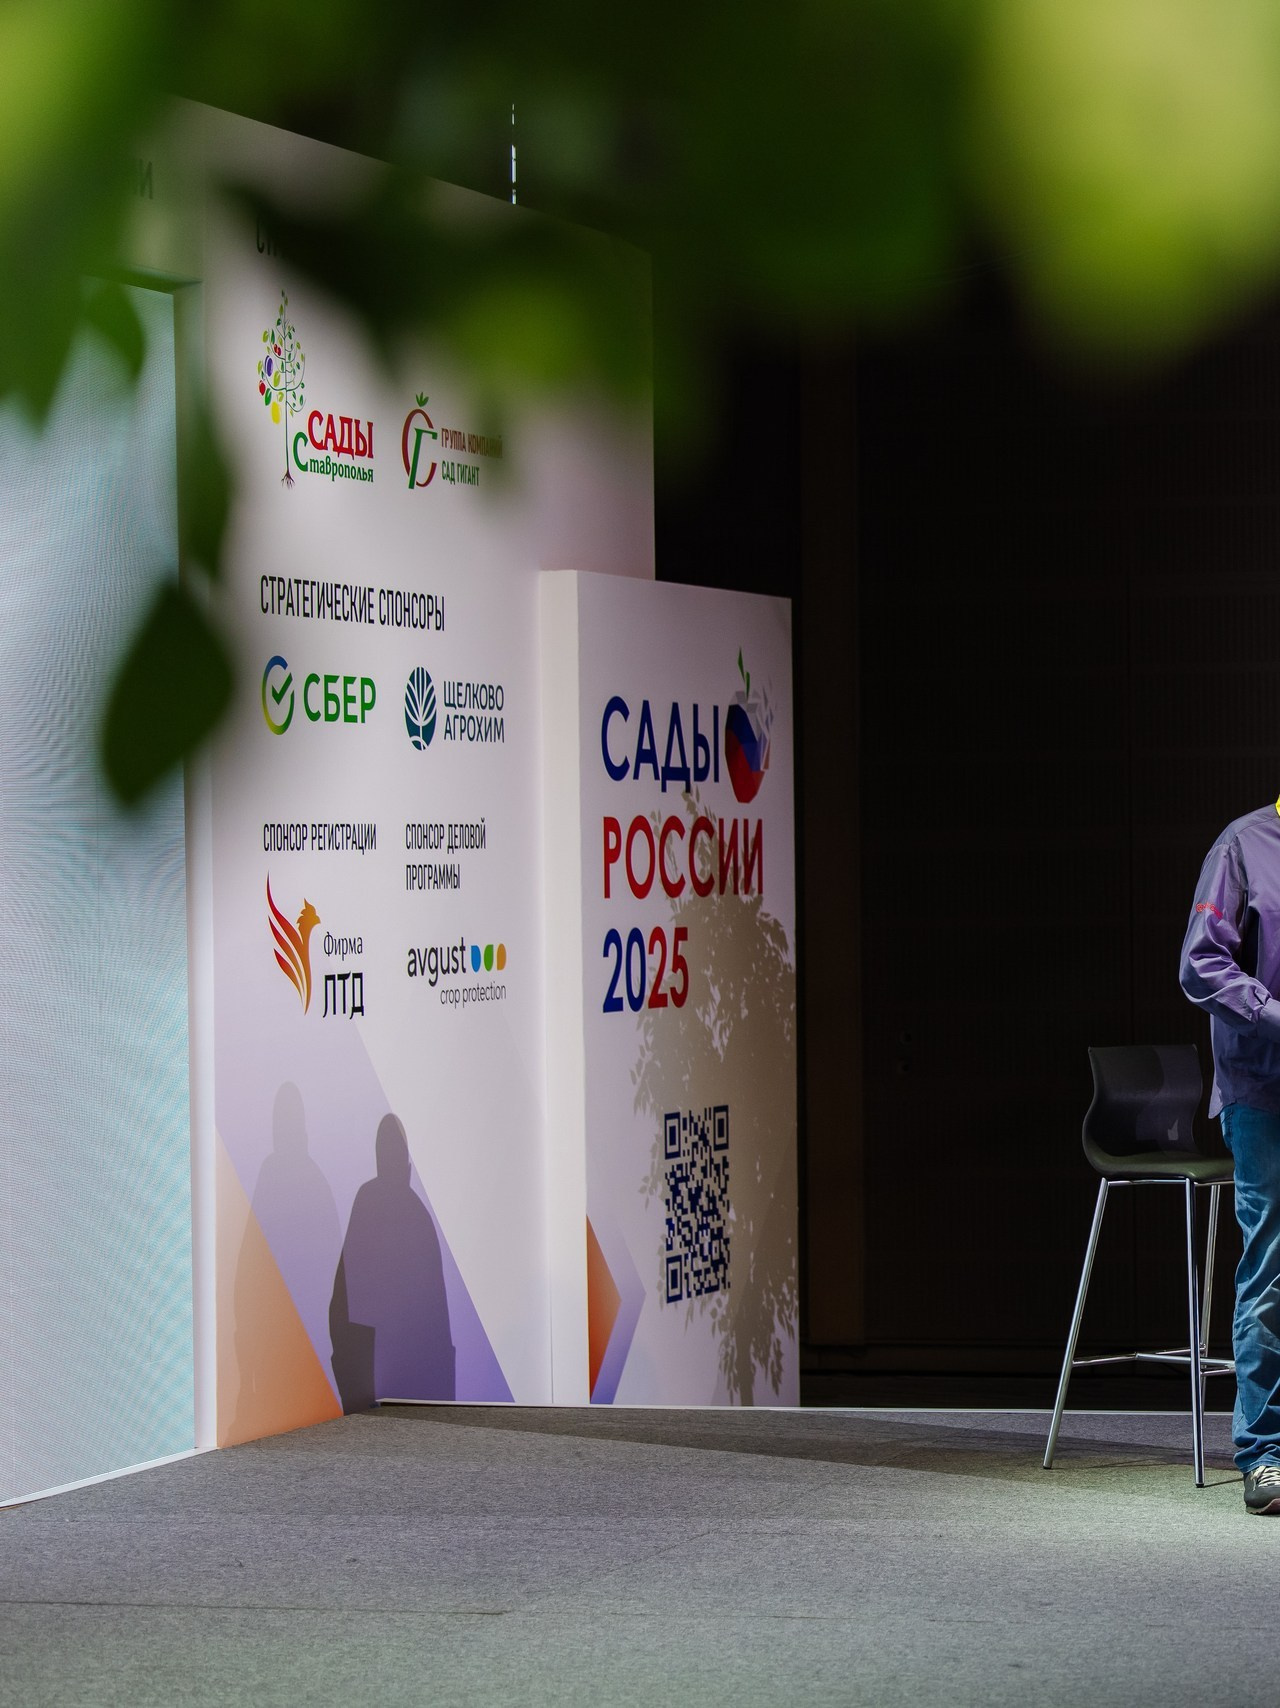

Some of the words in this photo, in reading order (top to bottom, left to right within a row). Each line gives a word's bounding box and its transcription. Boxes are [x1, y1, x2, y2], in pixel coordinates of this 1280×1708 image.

[308, 409, 374, 460] САДЫ
[441, 428, 467, 453] ГРУППА
[293, 431, 374, 483] Ставрополья
[441, 460, 456, 486] САД
[457, 463, 480, 487] ГИГАНТ
[260, 574, 375, 625] СТРАТЕГИЧЕСКИЕ
[378, 588, 445, 632] СПОНСОРЫ
[303, 672, 377, 724] СБЕР
[443, 680, 505, 712] ЩЕЛКОВО
[443, 714, 505, 743] АГРОХИМ
[601, 695, 720, 793] САДЫ
[263, 823, 308, 852] СПОНСОР
[311, 823, 377, 855] РЕГИСТРАЦИИ
[405, 823, 445, 850] СПОНСОР
[447, 817, 487, 854] ДЕЛОВОЙ
[405, 863, 461, 891] ПРОГРАММЫ
[603, 815, 764, 900] РОССИИ
[323, 931, 363, 961] Фирма
[407, 936, 467, 987] avgust
[602, 926, 690, 1014] 2025
[322, 970, 365, 1020] ЛТД
[440, 986, 461, 1009] crop
[462, 981, 507, 1008] protection
